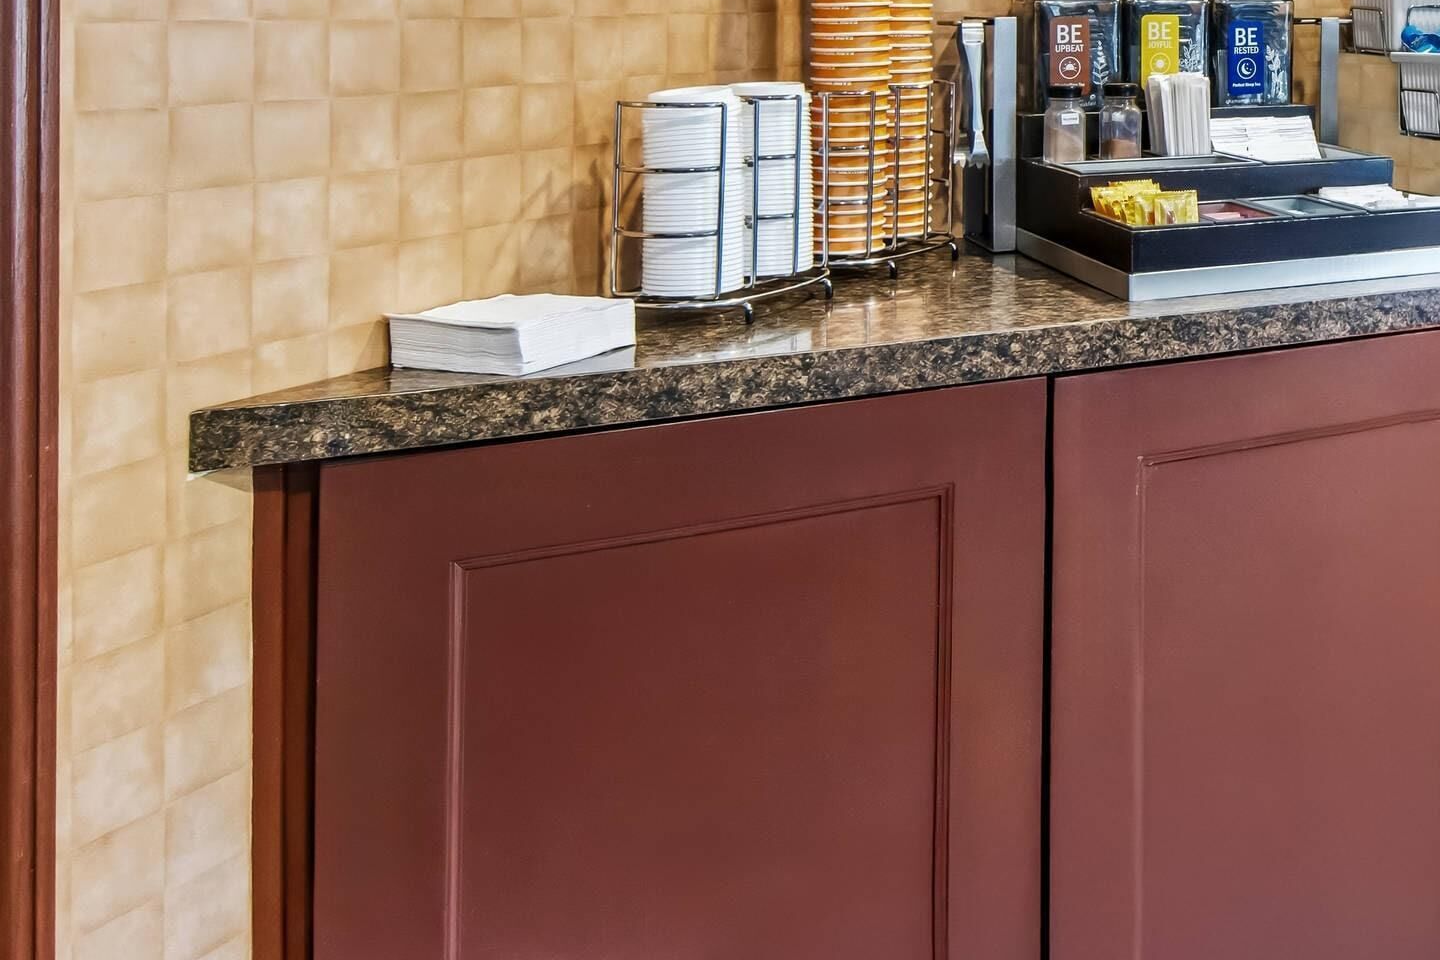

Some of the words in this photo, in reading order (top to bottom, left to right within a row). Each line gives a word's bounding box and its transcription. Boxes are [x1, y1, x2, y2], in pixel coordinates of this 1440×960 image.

[1057, 24, 1083, 44] BE
[1148, 21, 1172, 40] BE
[1235, 27, 1258, 46] BE
[1055, 44, 1084, 53] UPBEAT
[1148, 40, 1173, 49] JOYFUL
[1233, 46, 1259, 55] RESTED
